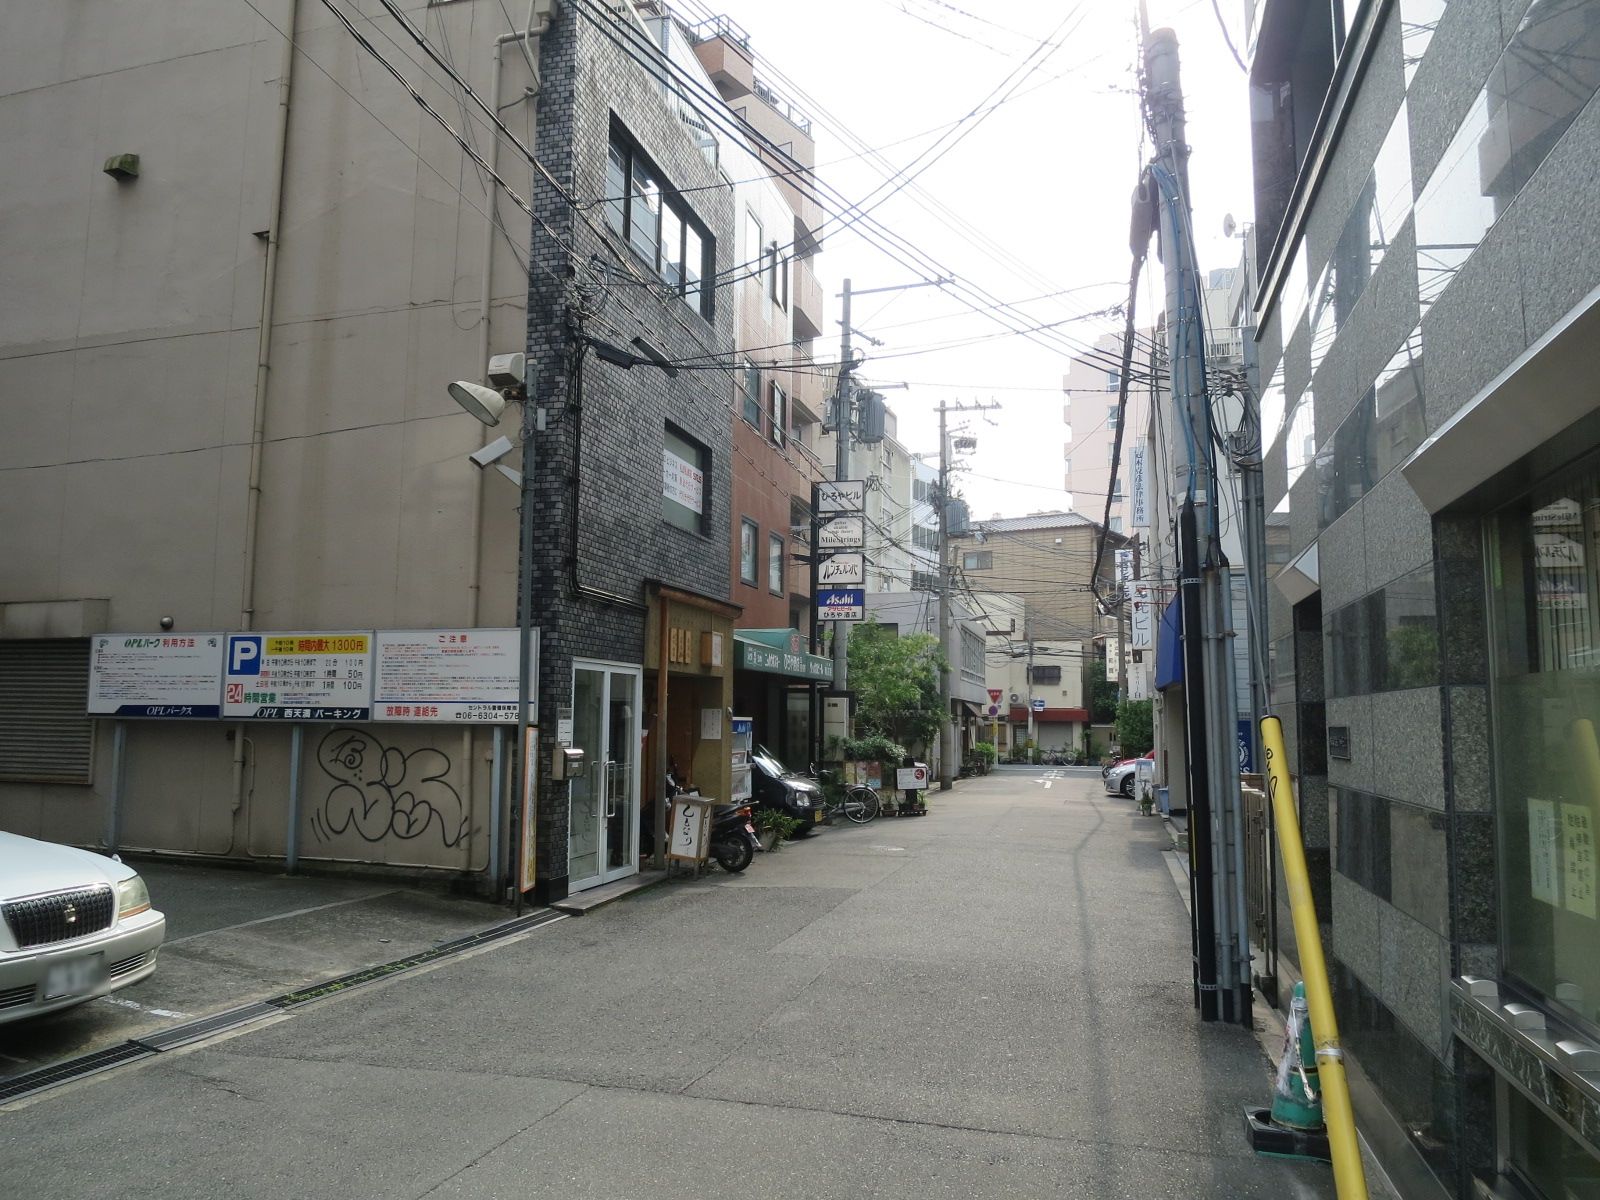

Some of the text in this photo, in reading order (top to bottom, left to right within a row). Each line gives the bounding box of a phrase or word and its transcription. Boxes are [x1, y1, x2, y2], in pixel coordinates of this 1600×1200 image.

[826, 593, 854, 605] Asahi
[232, 640, 258, 671] P
[227, 684, 242, 702] 24
[257, 708, 361, 718] OPL 西天満 パーキング
[414, 706, 438, 717] 連絡先
[462, 712, 520, 720] 06-6304-578
